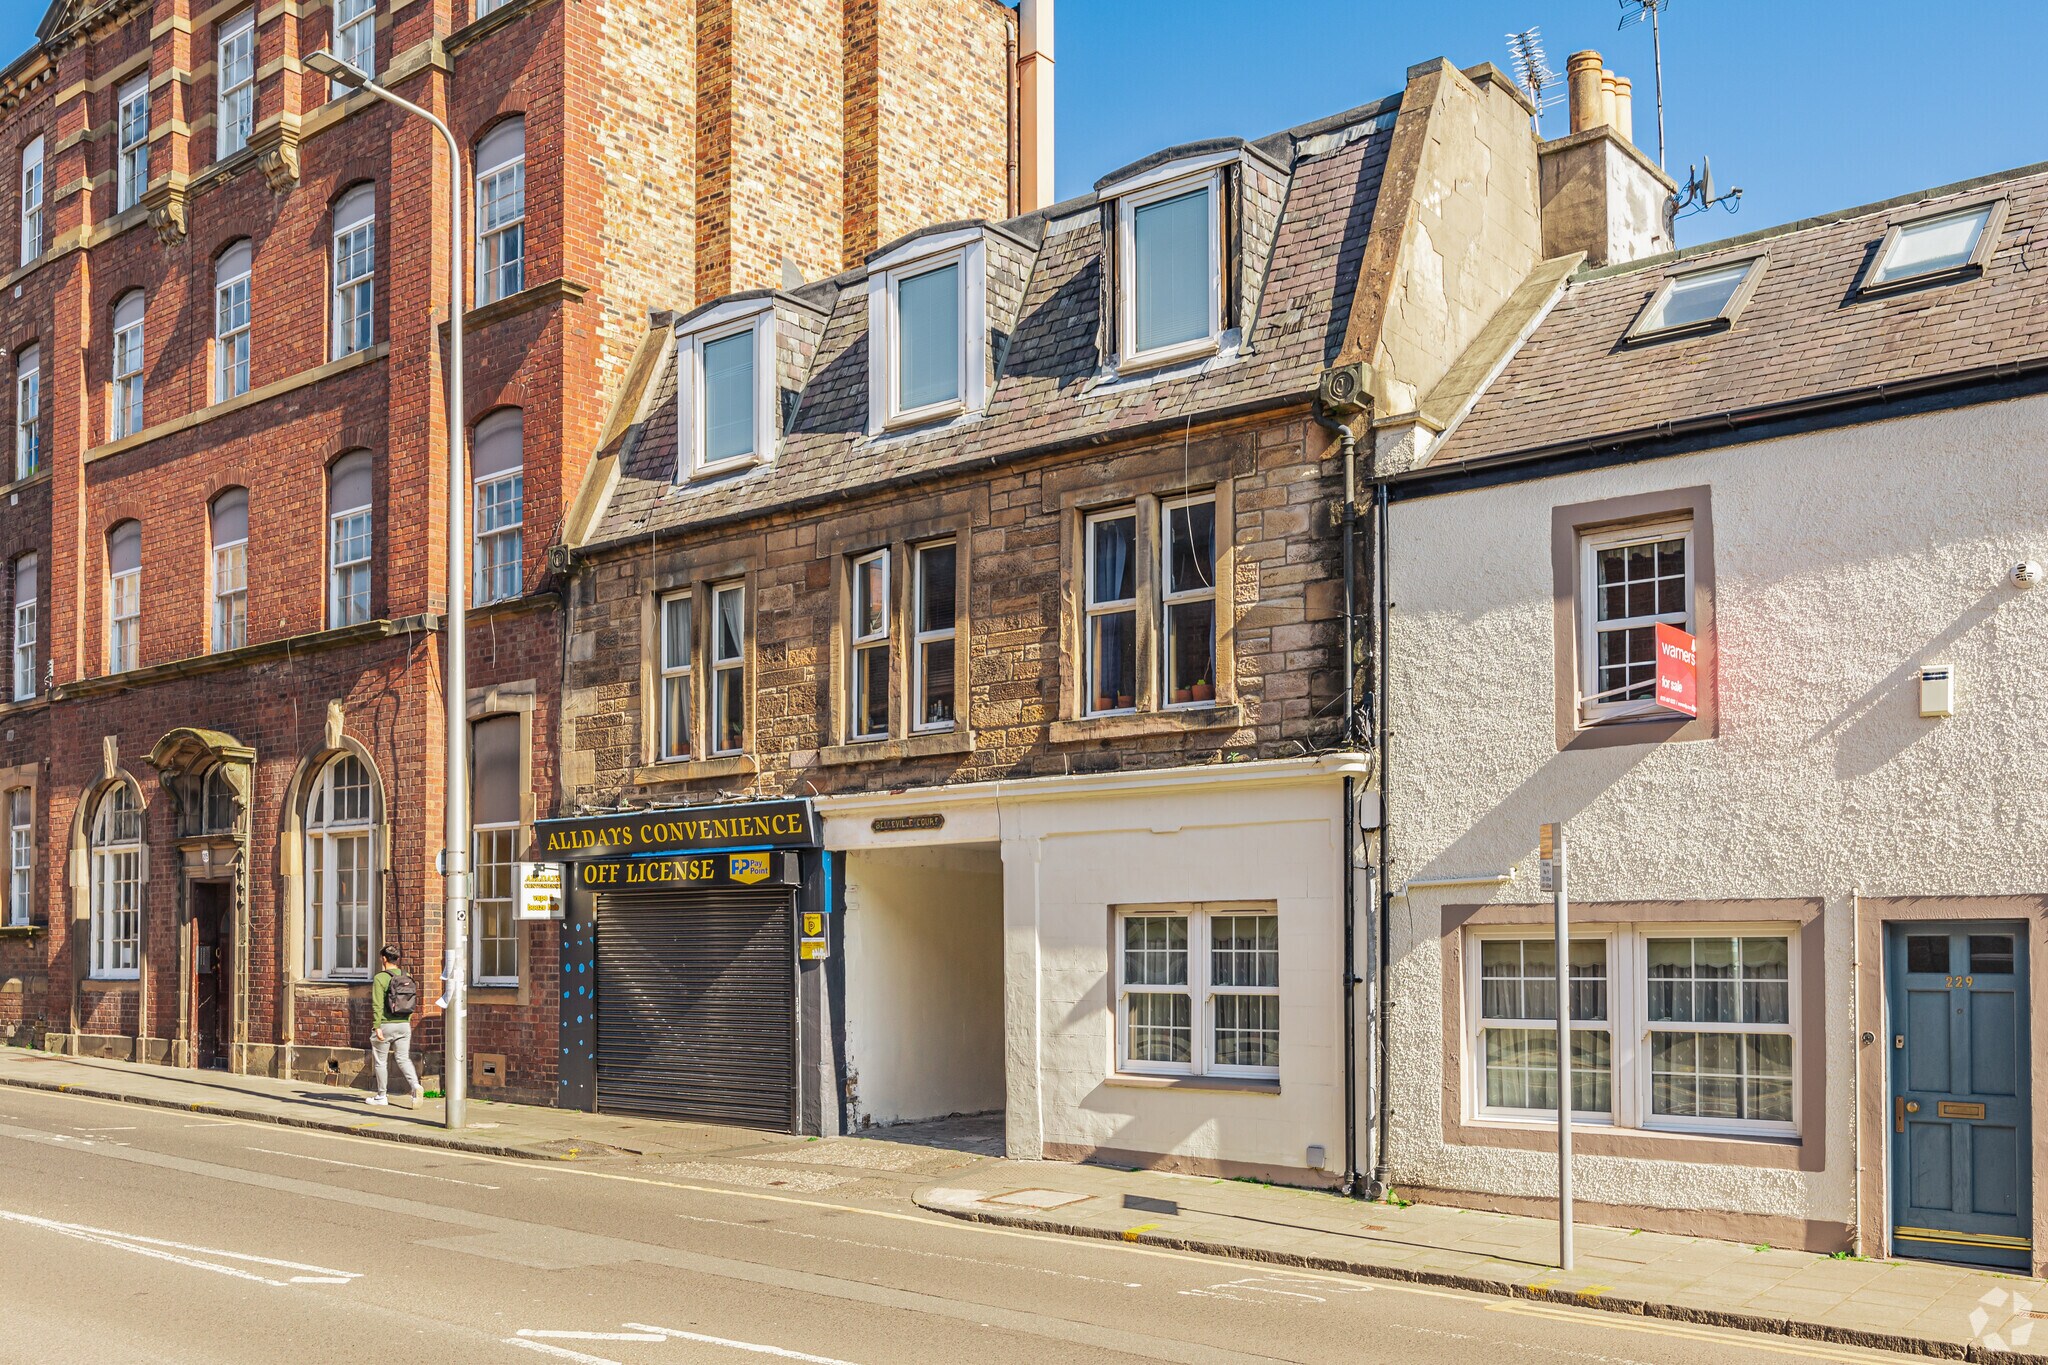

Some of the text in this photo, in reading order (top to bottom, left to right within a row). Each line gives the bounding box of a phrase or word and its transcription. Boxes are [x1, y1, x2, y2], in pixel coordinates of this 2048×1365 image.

[1661, 642, 1696, 666] warners
[1661, 675, 1683, 693] for sale
[875, 817, 939, 829] BELLEVILLE COURT
[547, 813, 803, 850] ALLDAYS CONVENIENCE
[750, 859, 763, 868] Pay
[750, 867, 769, 875] Point
[584, 859, 715, 884] OFF LICENSE
[1945, 976, 1974, 988] 229
